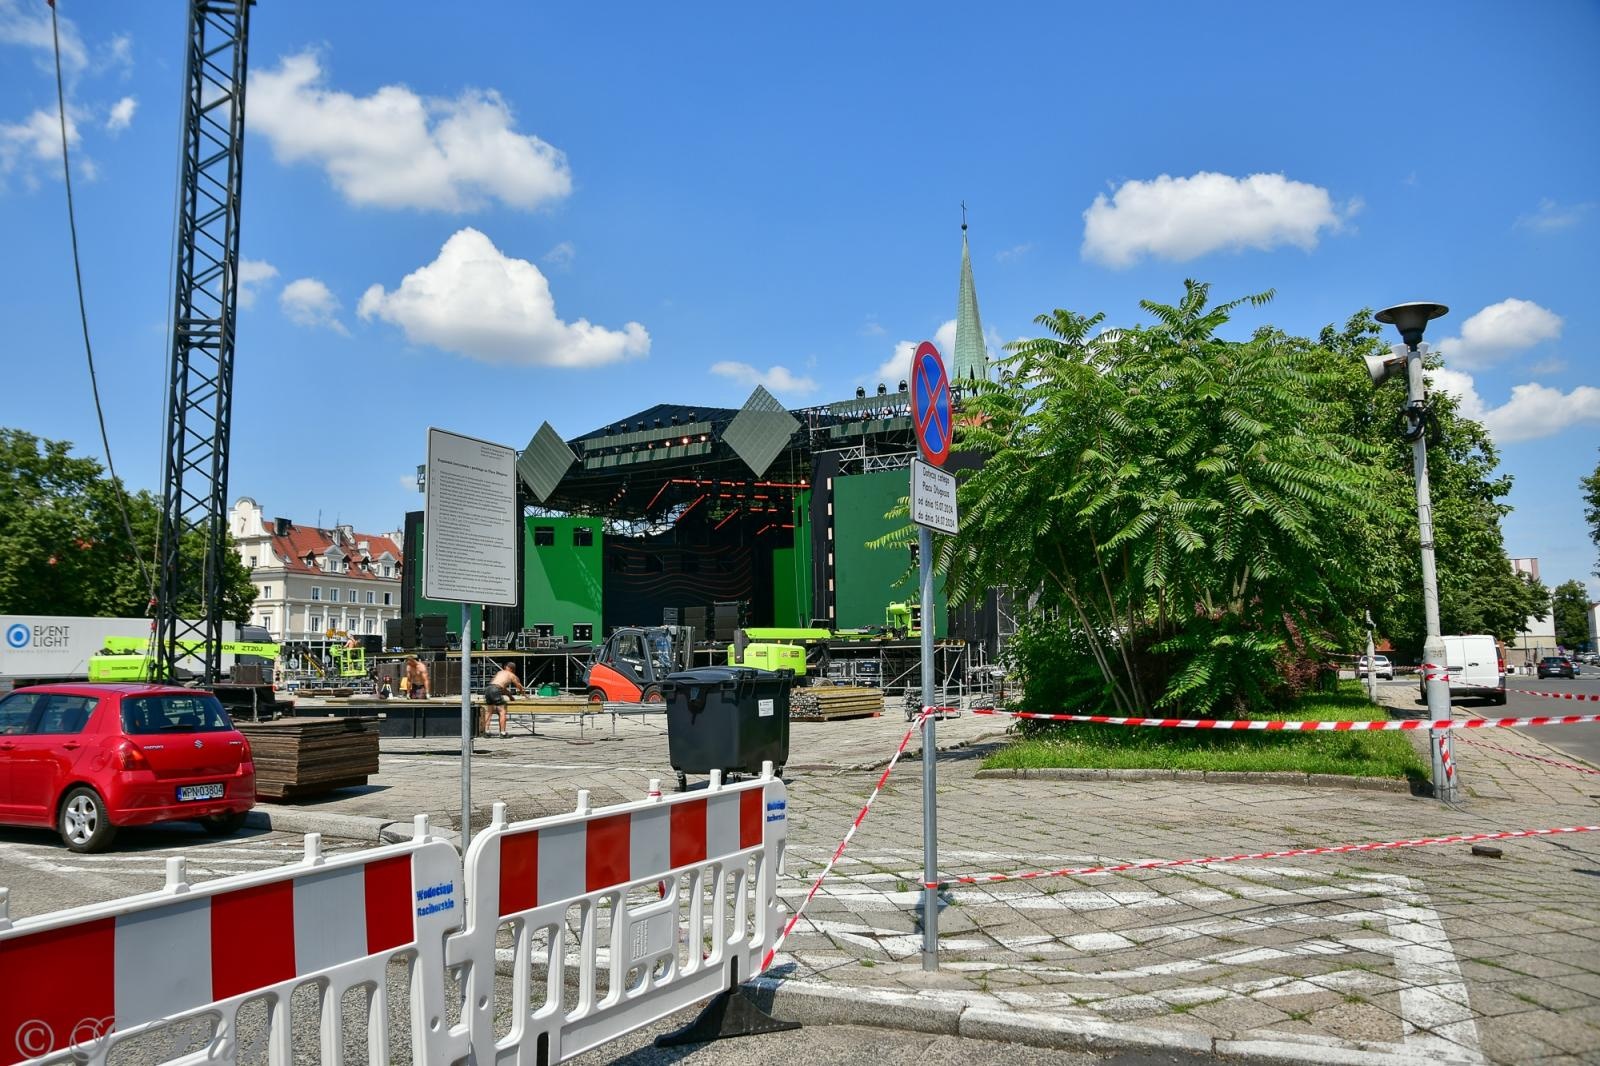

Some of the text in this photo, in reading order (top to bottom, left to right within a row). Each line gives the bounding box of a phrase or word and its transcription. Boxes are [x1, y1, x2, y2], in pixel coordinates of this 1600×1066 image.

[923, 481, 932, 492] Placu
[925, 499, 934, 508] dnia
[925, 514, 934, 522] dnia
[34, 626, 70, 636] EVENT
[33, 637, 69, 647] LIGHT
[200, 784, 223, 796] 03804
